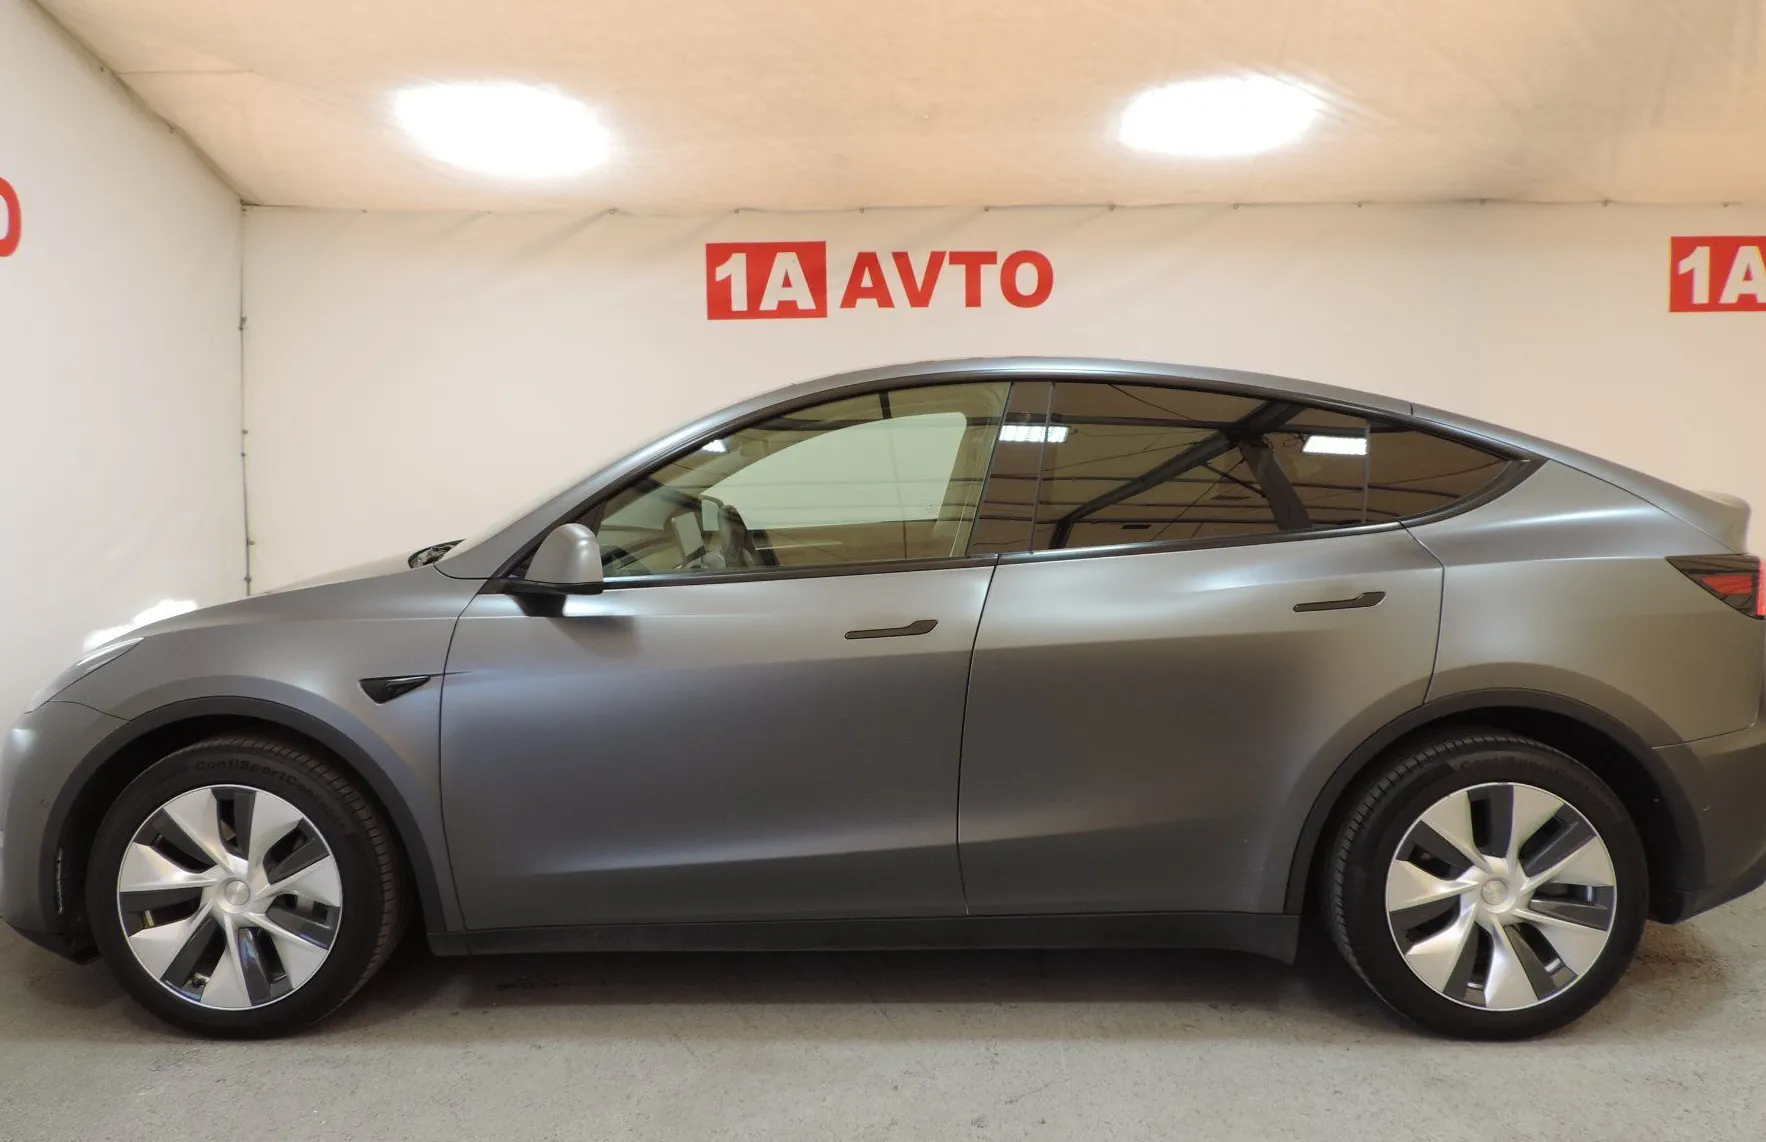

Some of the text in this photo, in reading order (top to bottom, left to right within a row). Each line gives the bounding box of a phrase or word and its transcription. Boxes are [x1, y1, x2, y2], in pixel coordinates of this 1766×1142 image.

[715, 250, 1054, 311] 1A AVTO
[1678, 245, 1766, 304] 1A
